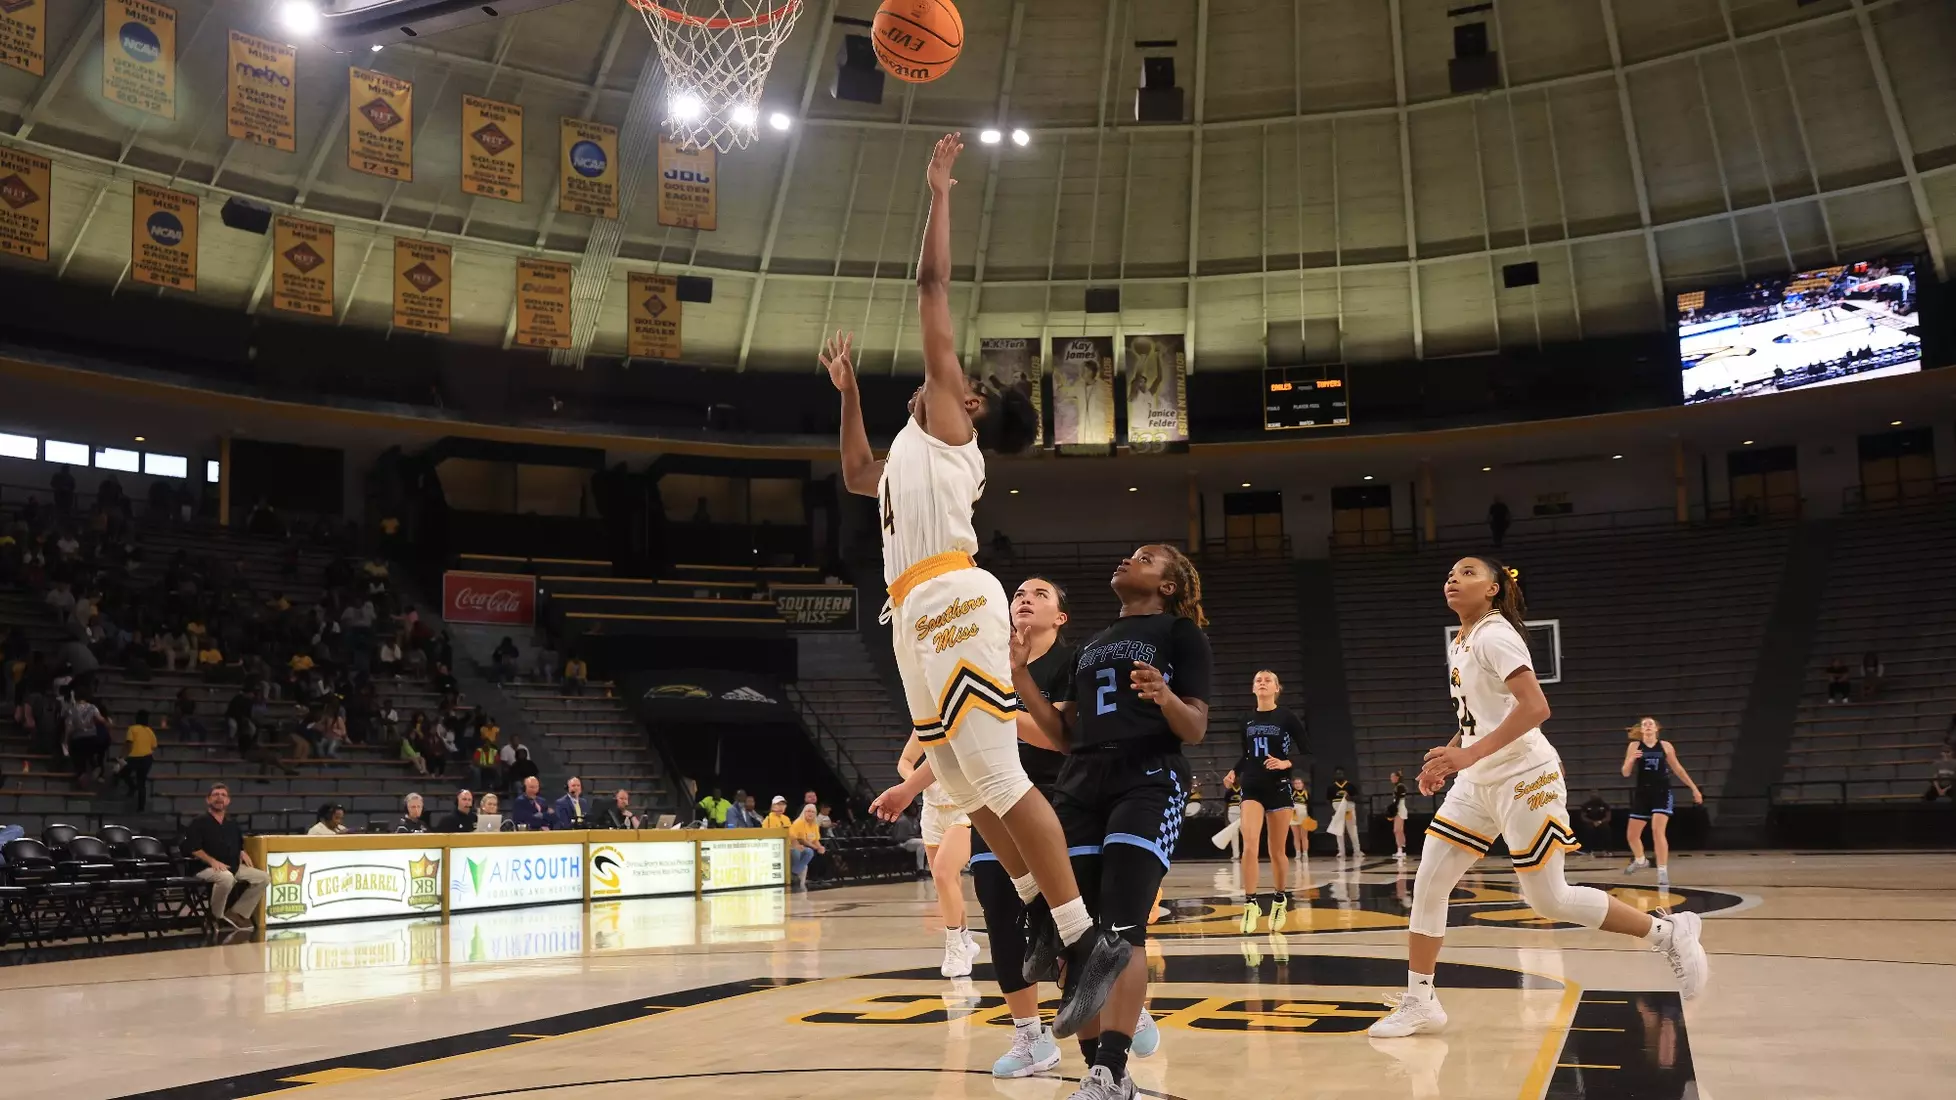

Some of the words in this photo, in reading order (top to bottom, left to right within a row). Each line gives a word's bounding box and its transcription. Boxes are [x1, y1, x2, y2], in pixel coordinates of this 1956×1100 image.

[125, 8, 156, 25] MISS
[124, 36, 158, 58] NCAA
[231, 31, 292, 58] SOUTHERN
[248, 47, 276, 63] MISS
[875, 43, 929, 79] Wilson
[236, 61, 290, 88] metro
[353, 70, 409, 92] SOUTHERN
[237, 83, 285, 104] GOLDEN
[368, 84, 394, 97] MISS
[465, 97, 519, 116] SOUTHERN
[480, 110, 505, 122] MISS
[563, 118, 615, 135] SOUTHERN
[357, 129, 403, 147] GOLDEN
[577, 130, 601, 141] MISS
[1, 160, 30, 175] MISS
[470, 154, 514, 169] GOLDEN
[573, 155, 605, 170] NCAA
[663, 180, 709, 195] GOLDEN
[137, 184, 195, 208] SOUTHERN
[665, 190, 709, 204] EAGLES
[153, 198, 180, 212] MISS
[150, 223, 182, 241] NCAA
[278, 218, 331, 235] SOUTHERN
[292, 230, 317, 241] MISS
[142, 242, 188, 259] GOLDEN
[398, 239, 448, 255] SOUTHERN
[143, 249, 187, 265] EAGLES
[411, 250, 435, 261] MISS
[520, 260, 568, 273] SOUTHERN
[532, 270, 555, 279] MISS
[402, 291, 442, 303] GOLDEN
[524, 297, 563, 308] GOLDEN
[525, 303, 562, 313] EAGLES
[634, 318, 676, 327] GOLDEN
[635, 326, 675, 335] EAGLES
[1005, 340, 1025, 349] Turk
[1071, 341, 1092, 352] Kay
[1066, 351, 1096, 361] James
[1176, 352, 1187, 407] SOUTHERN
[1271, 383, 1292, 392] EAGLES
[1148, 409, 1176, 419] Janice
[1148, 419, 1177, 428] Felder
[455, 587, 521, 612] Coca-Cola
[776, 596, 852, 610] SOUTHERN
[797, 611, 827, 623] MISS
[915, 595, 987, 642] Southern
[932, 622, 979, 653] Miss
[1096, 667, 1118, 716] 2
[1253, 737, 1269, 757] 14
[1644, 758, 1659, 771] 24
[1513, 770, 1560, 800] Southern
[1527, 790, 1559, 812] Miss
[489, 856, 580, 883] AIRSOUTH
[316, 876, 340, 897] KEG
[355, 872, 398, 892] BARREL
[549, 885, 581, 895] HEATING
